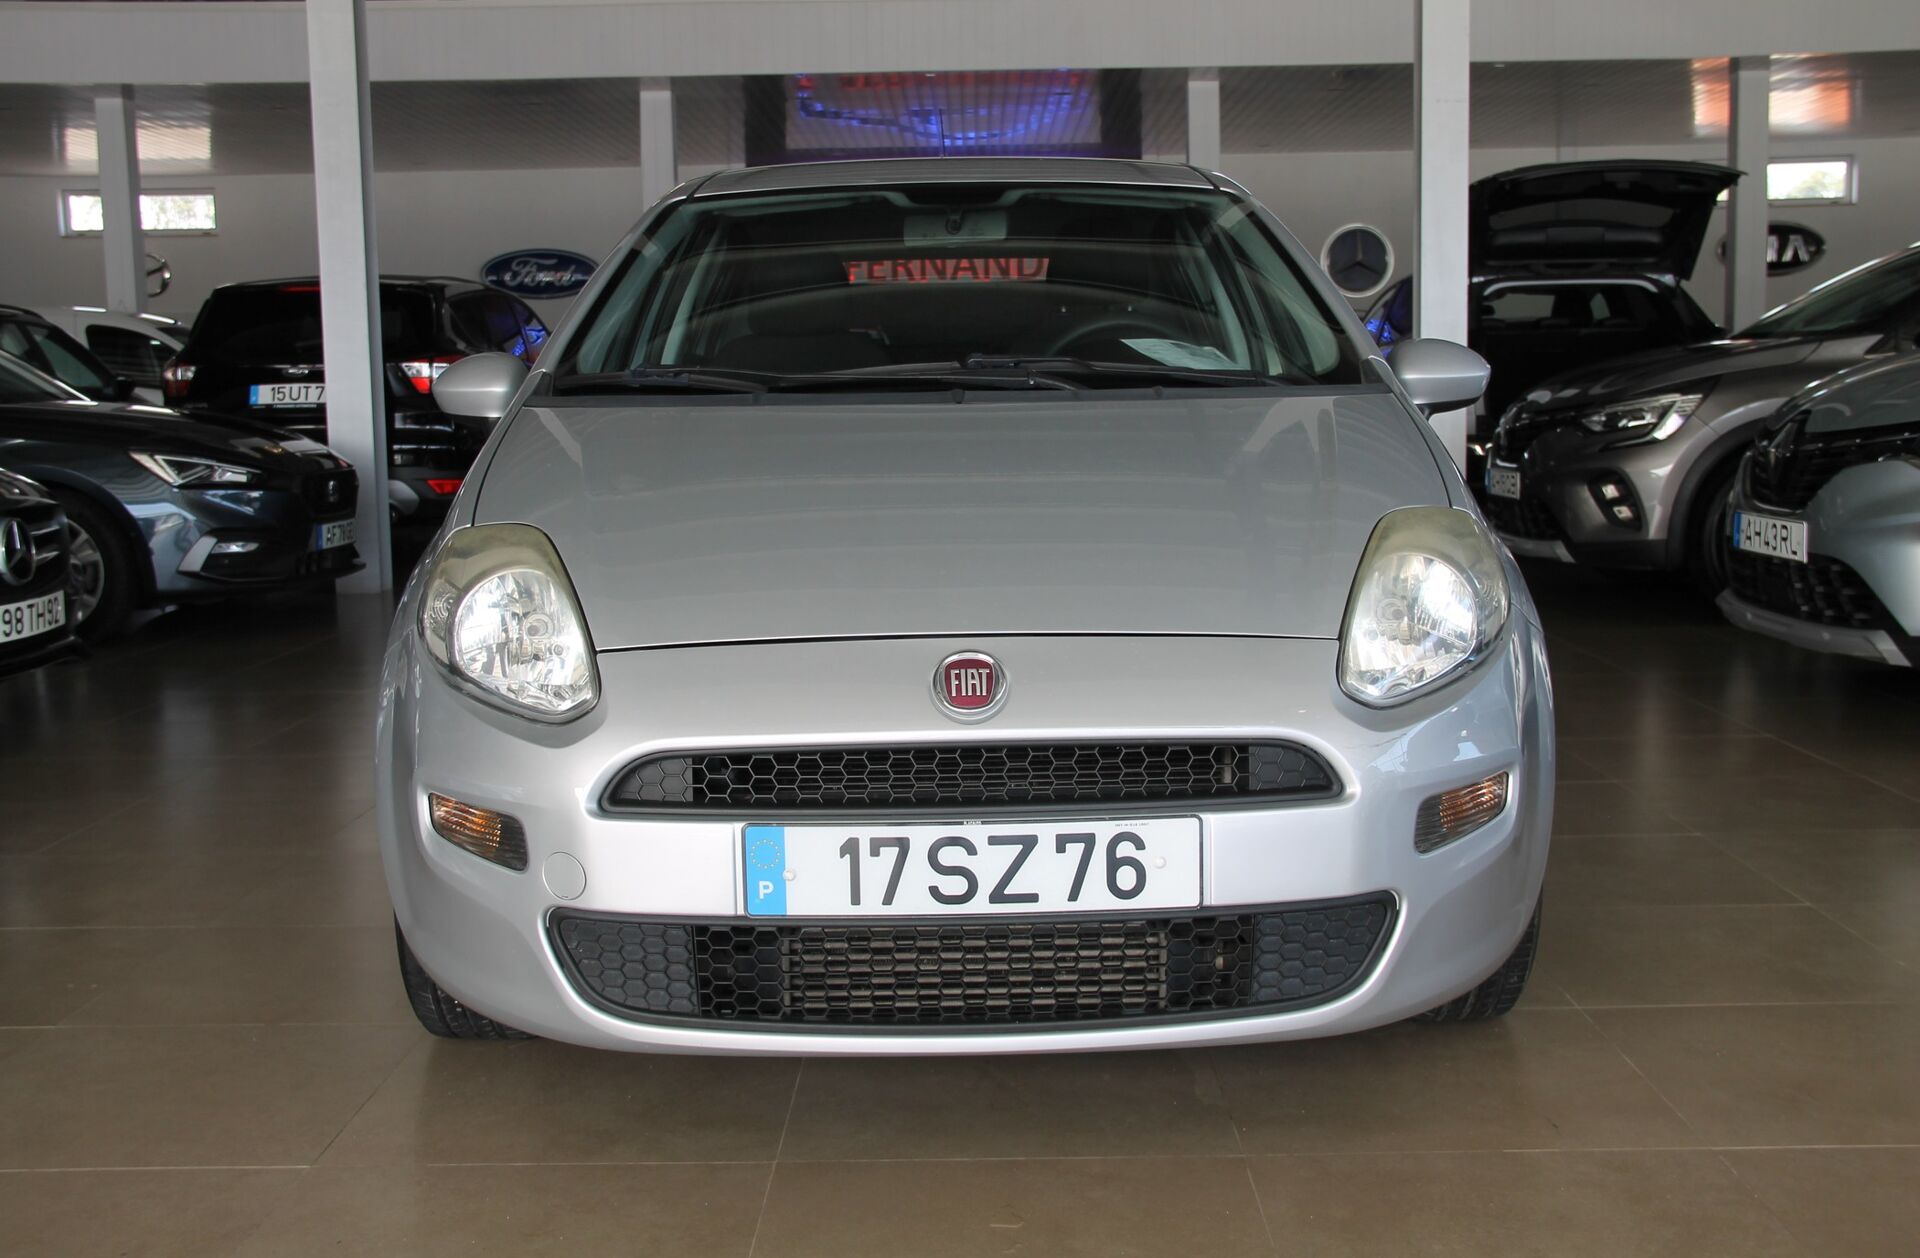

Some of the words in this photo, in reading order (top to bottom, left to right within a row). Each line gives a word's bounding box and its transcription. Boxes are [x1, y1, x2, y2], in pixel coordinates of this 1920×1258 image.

[1766, 234, 1810, 262] IA
[504, 257, 576, 286] Ford
[271, 385, 325, 402] 15UT7
[950, 668, 990, 697] FIAT
[758, 880, 774, 899] P
